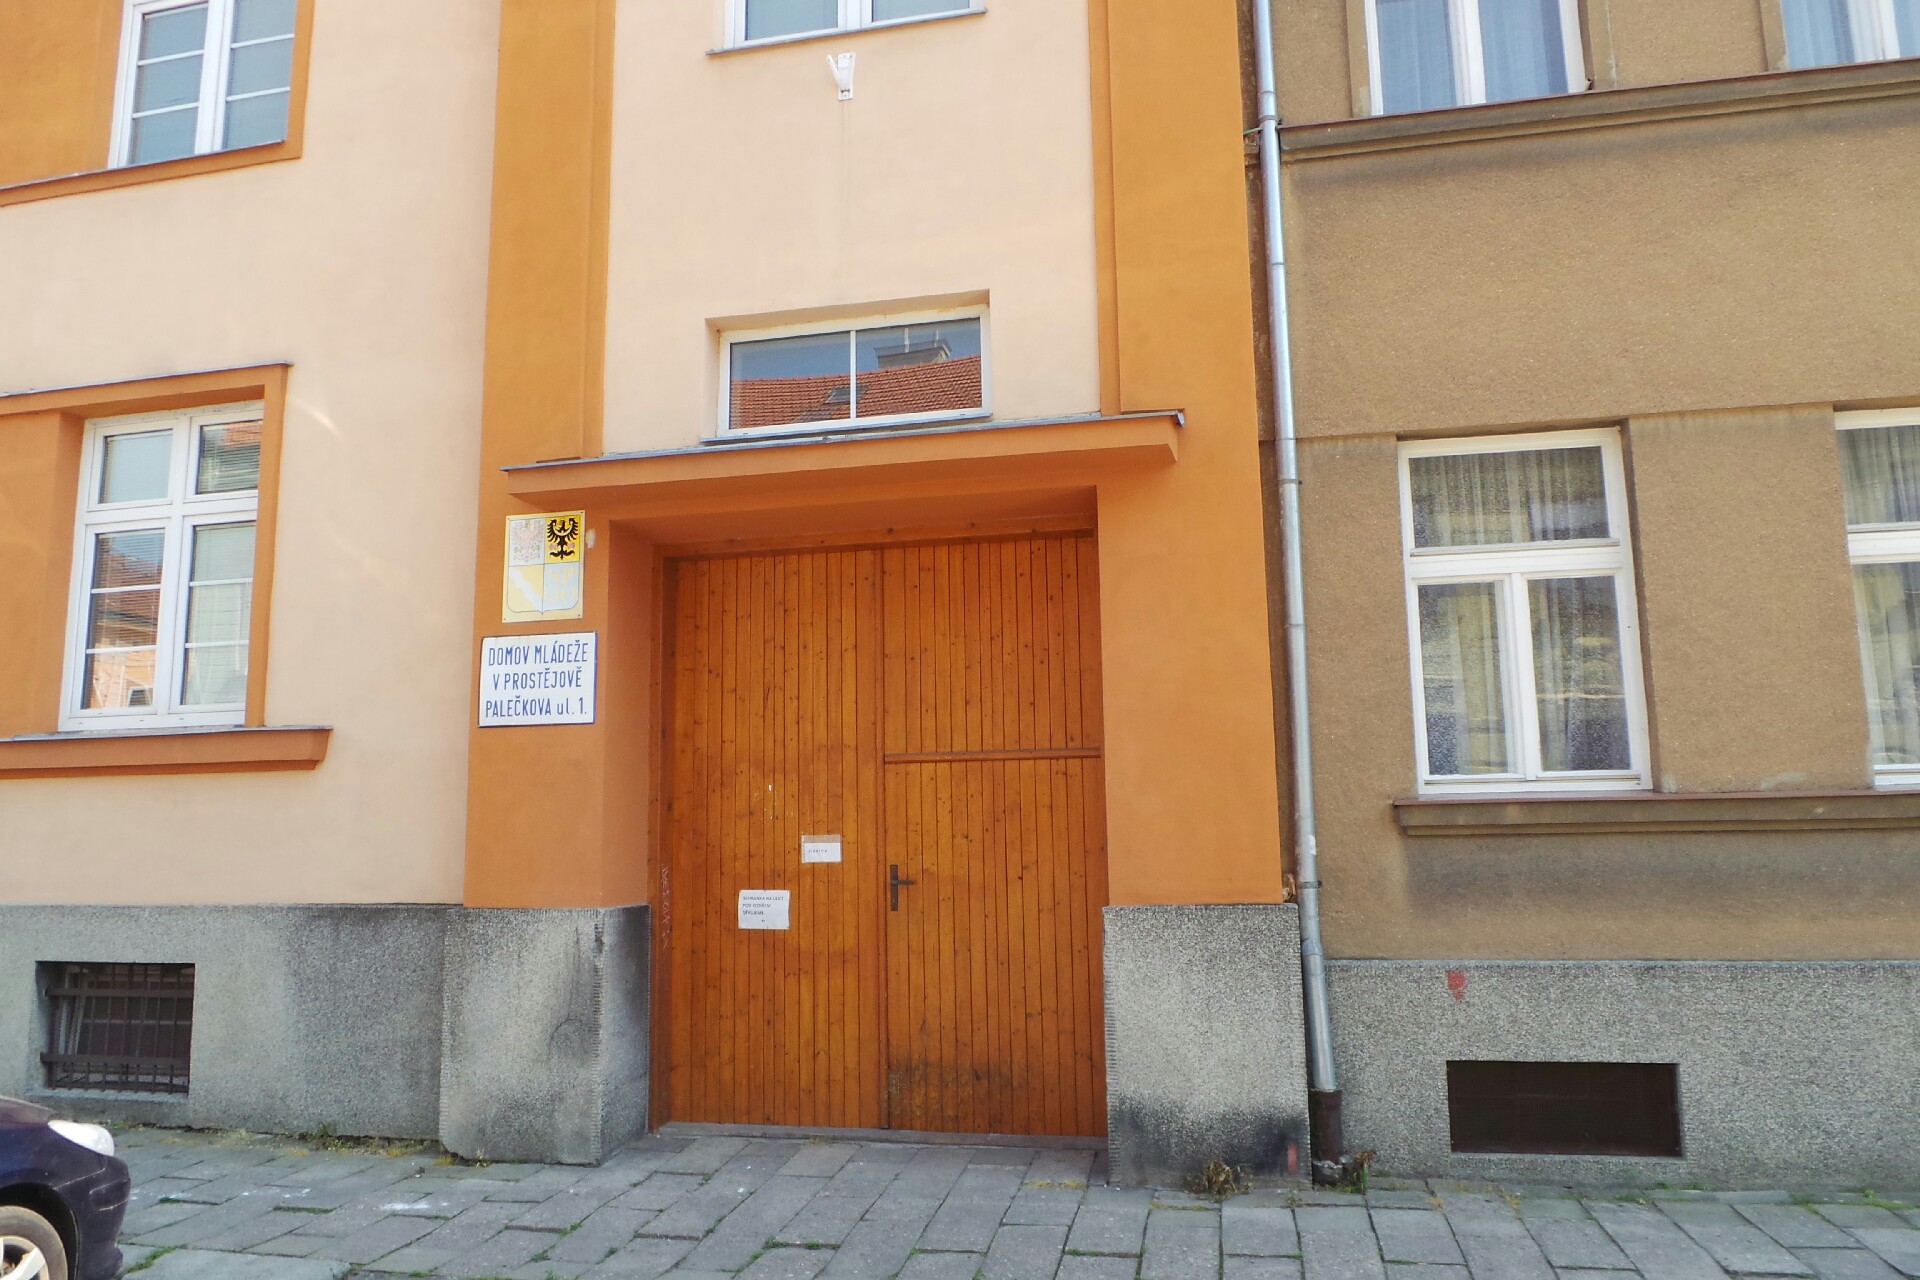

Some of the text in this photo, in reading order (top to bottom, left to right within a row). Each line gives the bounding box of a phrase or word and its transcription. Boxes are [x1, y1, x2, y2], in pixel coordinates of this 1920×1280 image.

[488, 640, 589, 666] DOMOV MLÁDEŽE
[493, 666, 582, 691] V PROSTĚJOVĚ
[485, 695, 587, 718] PALEČKOVA ul. 1.
